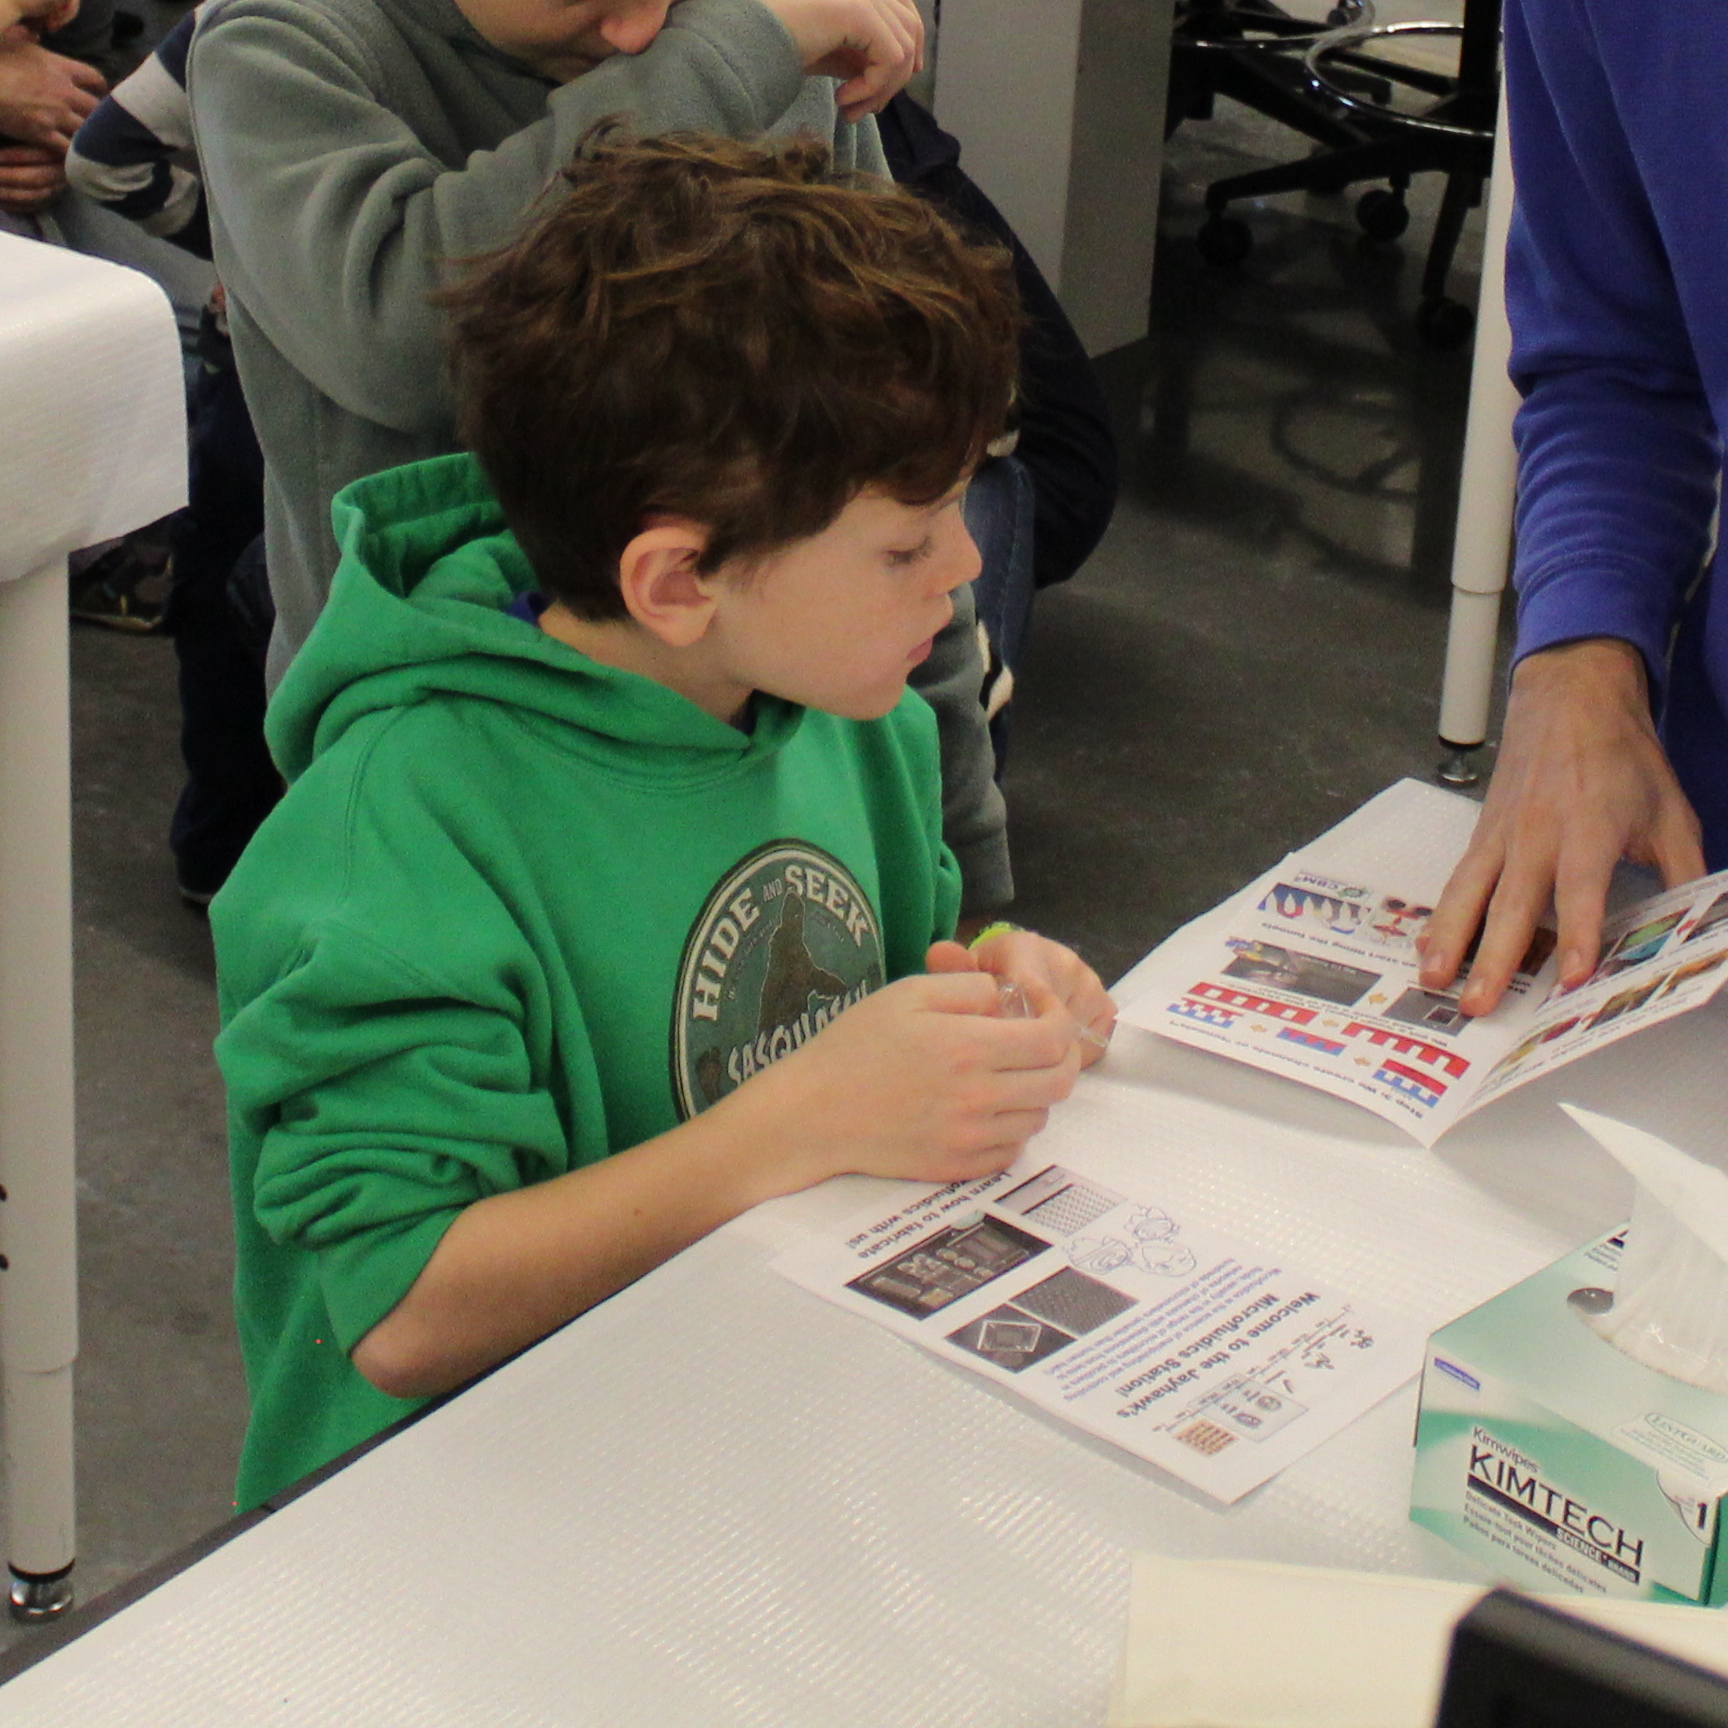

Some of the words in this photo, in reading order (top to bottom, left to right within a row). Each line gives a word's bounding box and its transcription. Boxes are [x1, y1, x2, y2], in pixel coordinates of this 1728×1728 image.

[693, 887, 760, 1021] HIDE
[762, 878, 783, 901] AND
[784, 864, 870, 947] SEEK
[936, 1193, 973, 1215] how
[966, 1169, 1014, 1198] Learn
[866, 1213, 906, 1236] with
[918, 1210, 943, 1224] to
[842, 1232, 873, 1249] us!
[854, 1219, 927, 1263] fabricate
[1171, 1292, 1286, 1362] Microfluidics
[1241, 1290, 1323, 1340] Welcome
[1196, 1350, 1234, 1372] the
[1223, 1337, 1252, 1353] to
[1111, 1355, 1186, 1400] Station!
[1112, 1365, 1205, 1422] Jayhawk's
[1473, 1425, 1539, 1474] Kimwipes
[1464, 1503, 1512, 1536] Essuie-tout
[1466, 1490, 1502, 1520] Delicate
[1502, 1509, 1523, 1531] Task
[1524, 1521, 1557, 1551] Wipers
[1469, 1444, 1645, 1567] KIMTECH
[1698, 1502, 1708, 1530] 1
[1490, 1533, 1512, 1552] para
[1512, 1544, 1541, 1567] tareas
[1541, 1558, 1585, 1593] delicadas
[1555, 1526, 1607, 1565] SCIENCE
